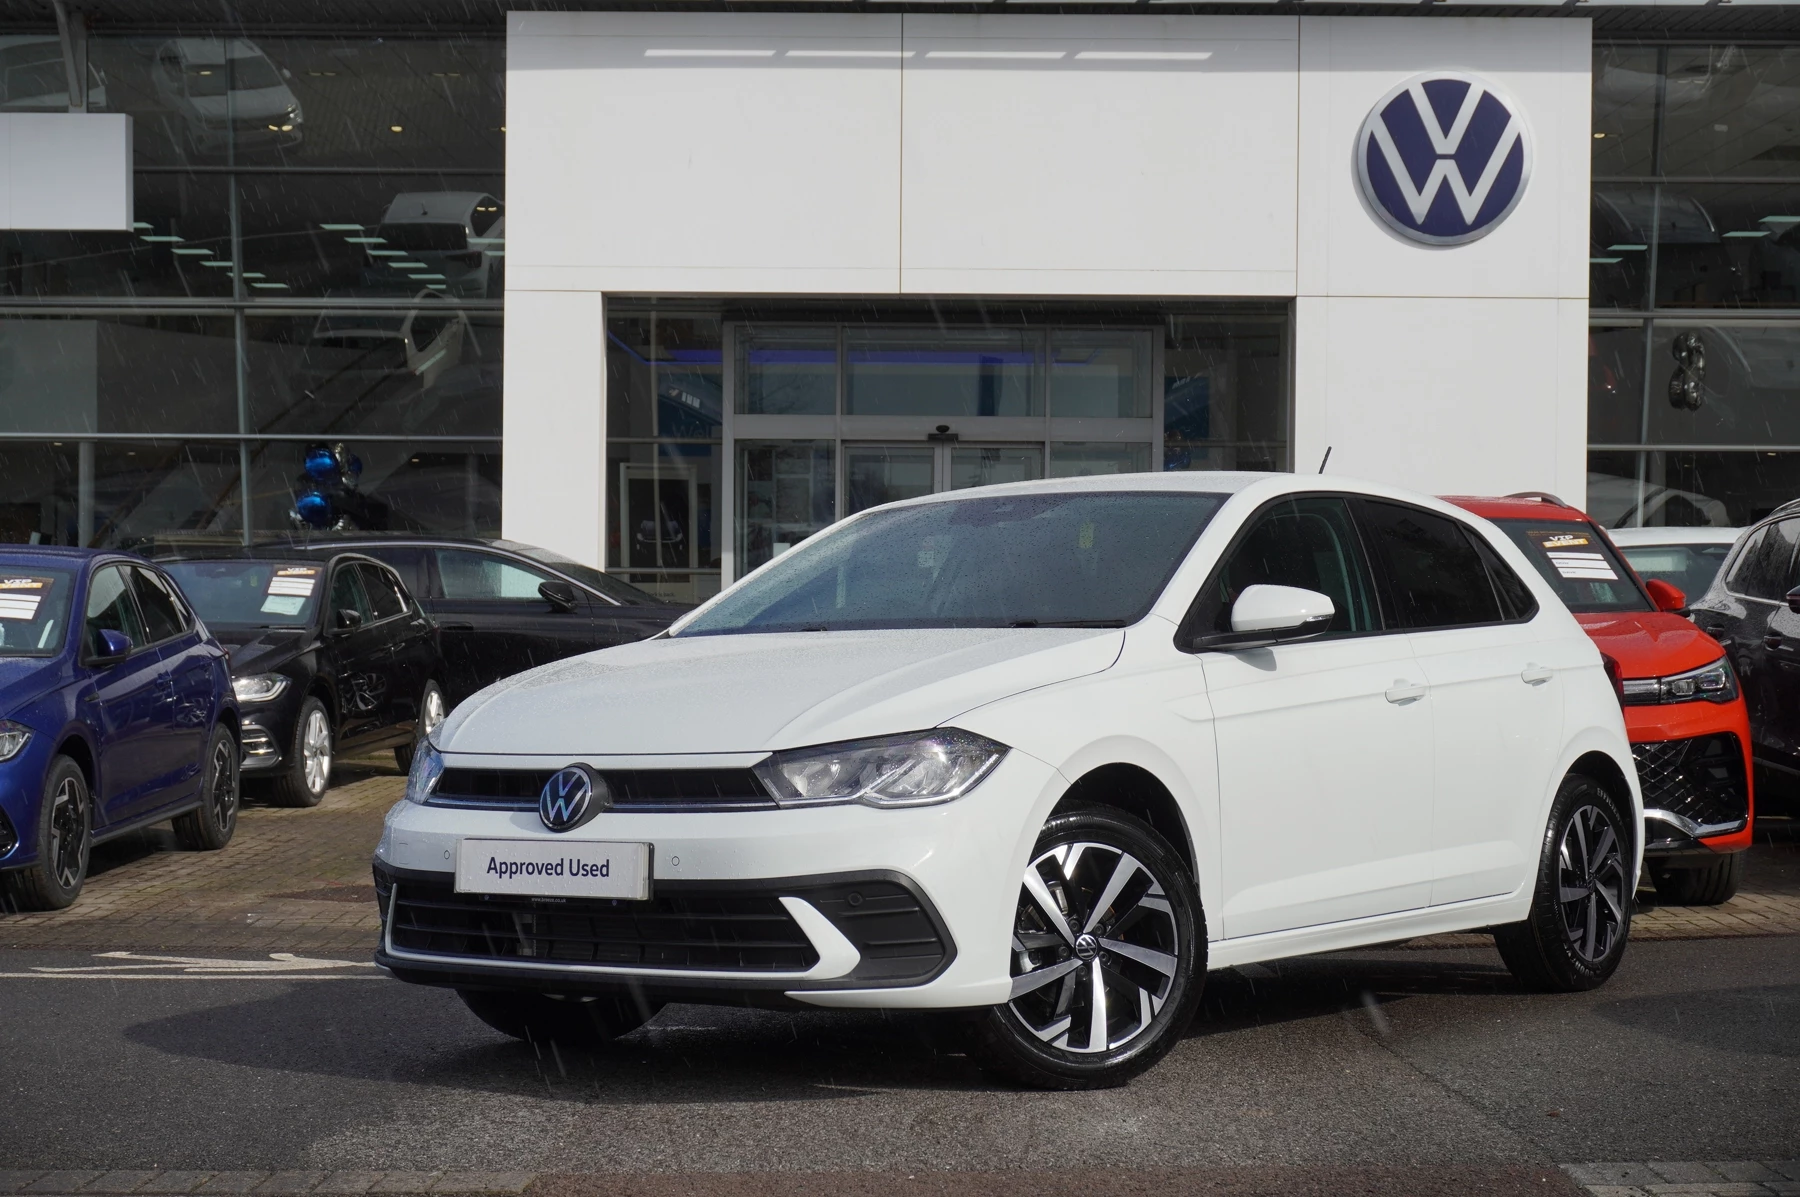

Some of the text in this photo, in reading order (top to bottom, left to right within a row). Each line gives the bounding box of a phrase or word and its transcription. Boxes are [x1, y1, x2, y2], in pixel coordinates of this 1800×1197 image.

[1365, 76, 1525, 230] VW
[542, 768, 590, 825] VW
[486, 856, 610, 879] Approved Used
